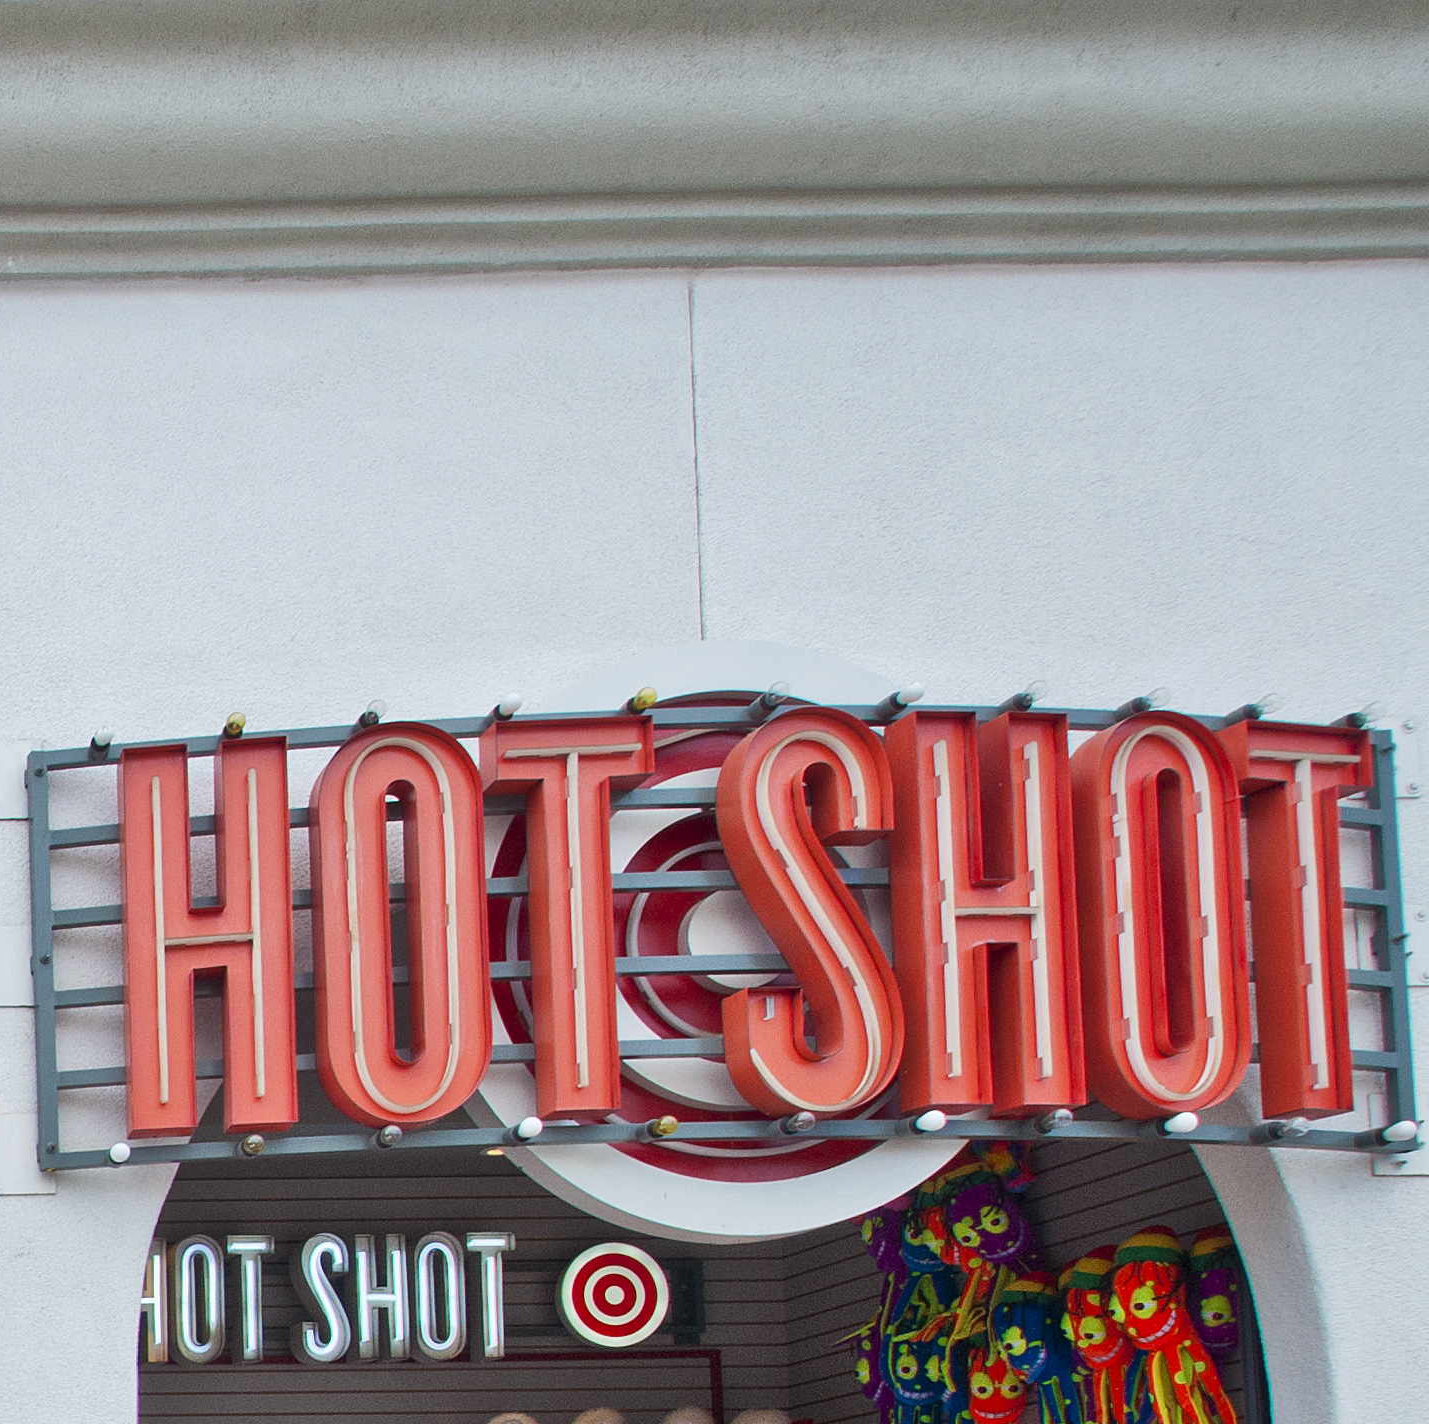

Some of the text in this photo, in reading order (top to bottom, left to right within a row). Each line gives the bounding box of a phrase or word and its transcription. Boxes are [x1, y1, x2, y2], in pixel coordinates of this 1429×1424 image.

[117, 707, 1374, 1139] HOT SHOT
[296, 1231, 516, 1362] SHOT
